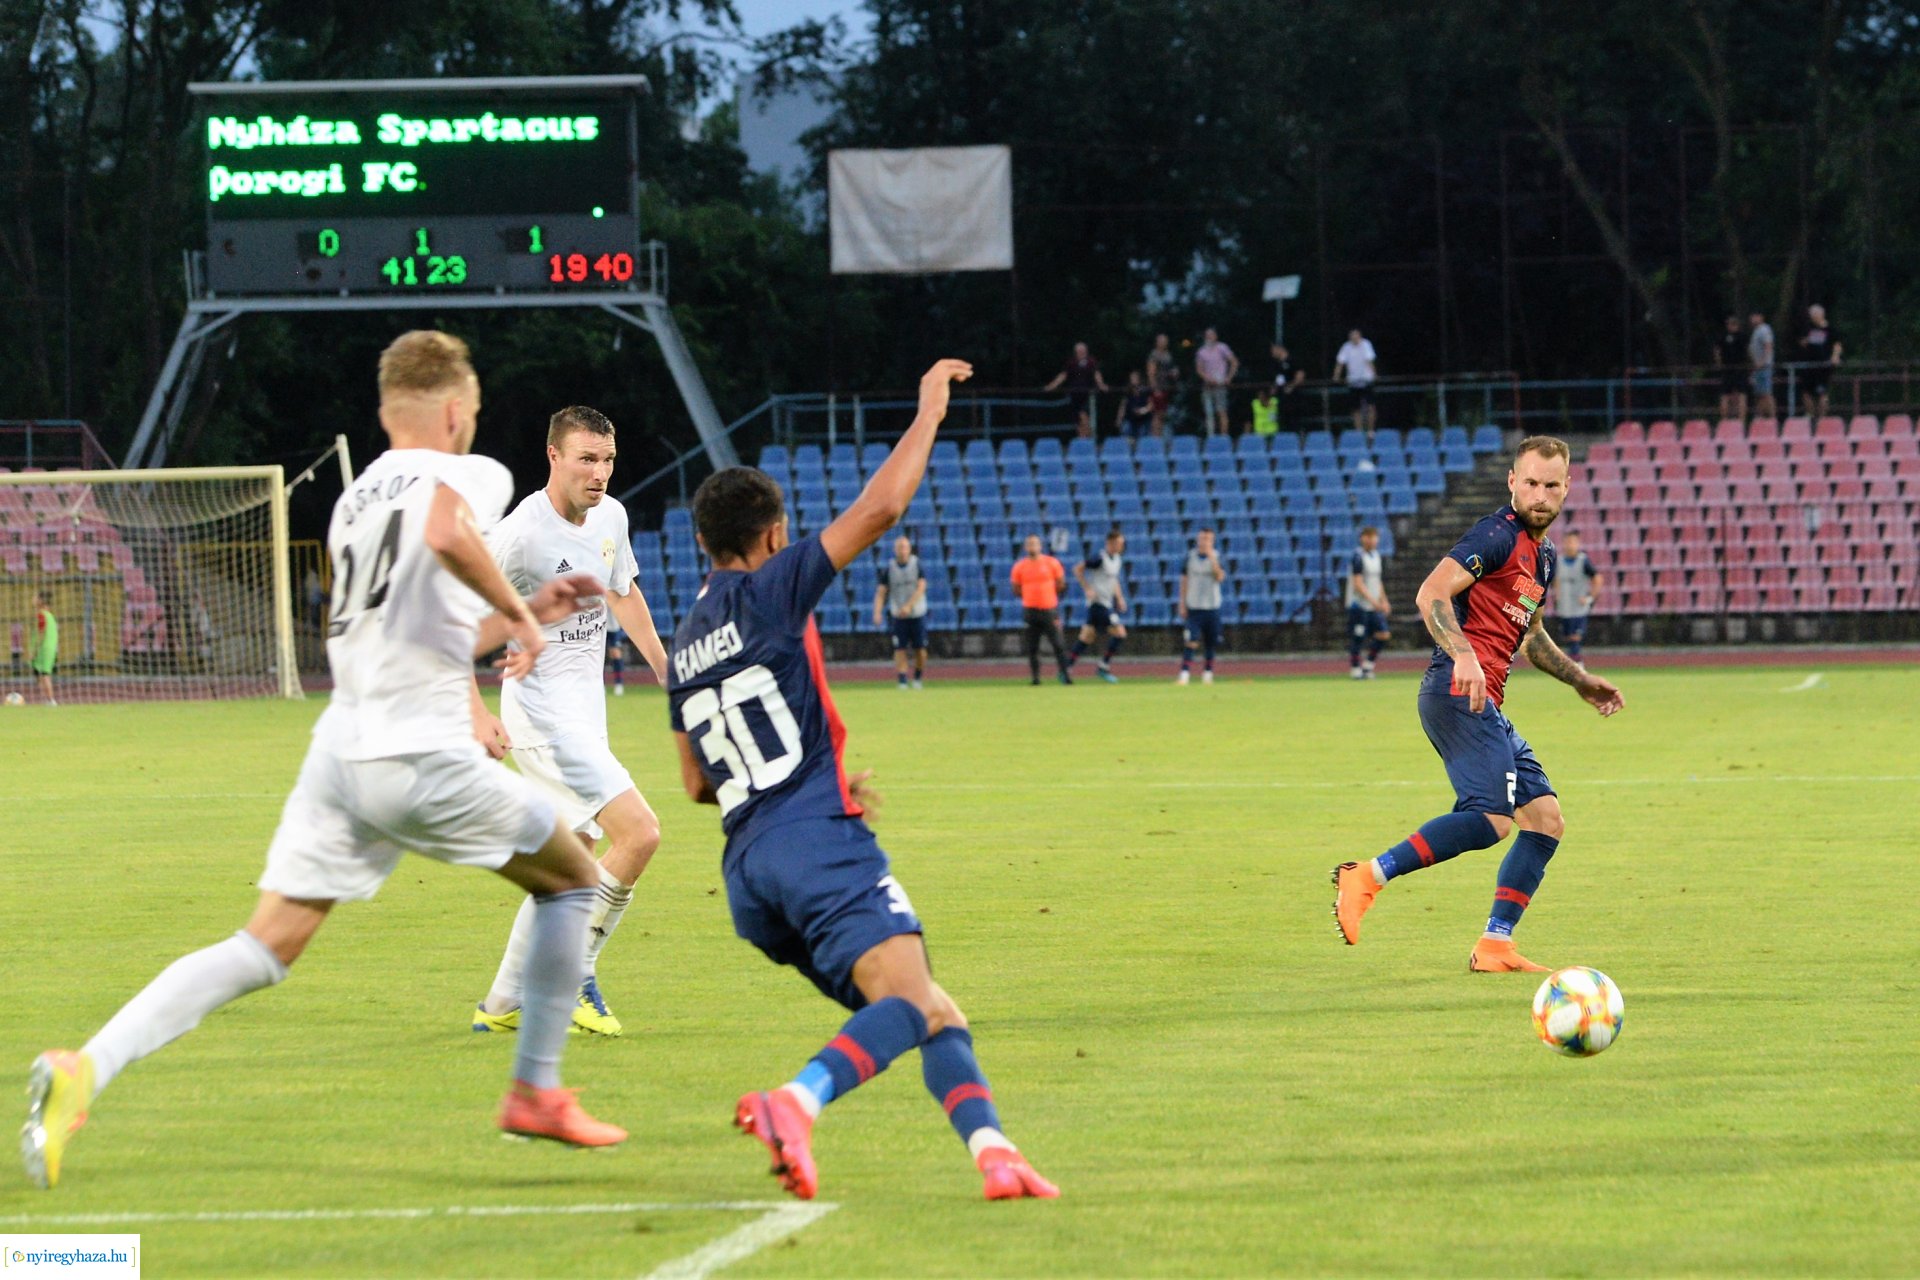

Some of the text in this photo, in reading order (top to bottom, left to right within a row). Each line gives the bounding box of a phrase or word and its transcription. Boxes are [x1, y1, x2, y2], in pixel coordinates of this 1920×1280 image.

[207, 112, 599, 149] Nyháza Spartacus
[362, 162, 418, 192] FC
[319, 229, 339, 256] 0
[415, 228, 430, 256] 1
[528, 226, 543, 254] 1
[674, 621, 743, 684] HAMED
[681, 664, 804, 818] 30
